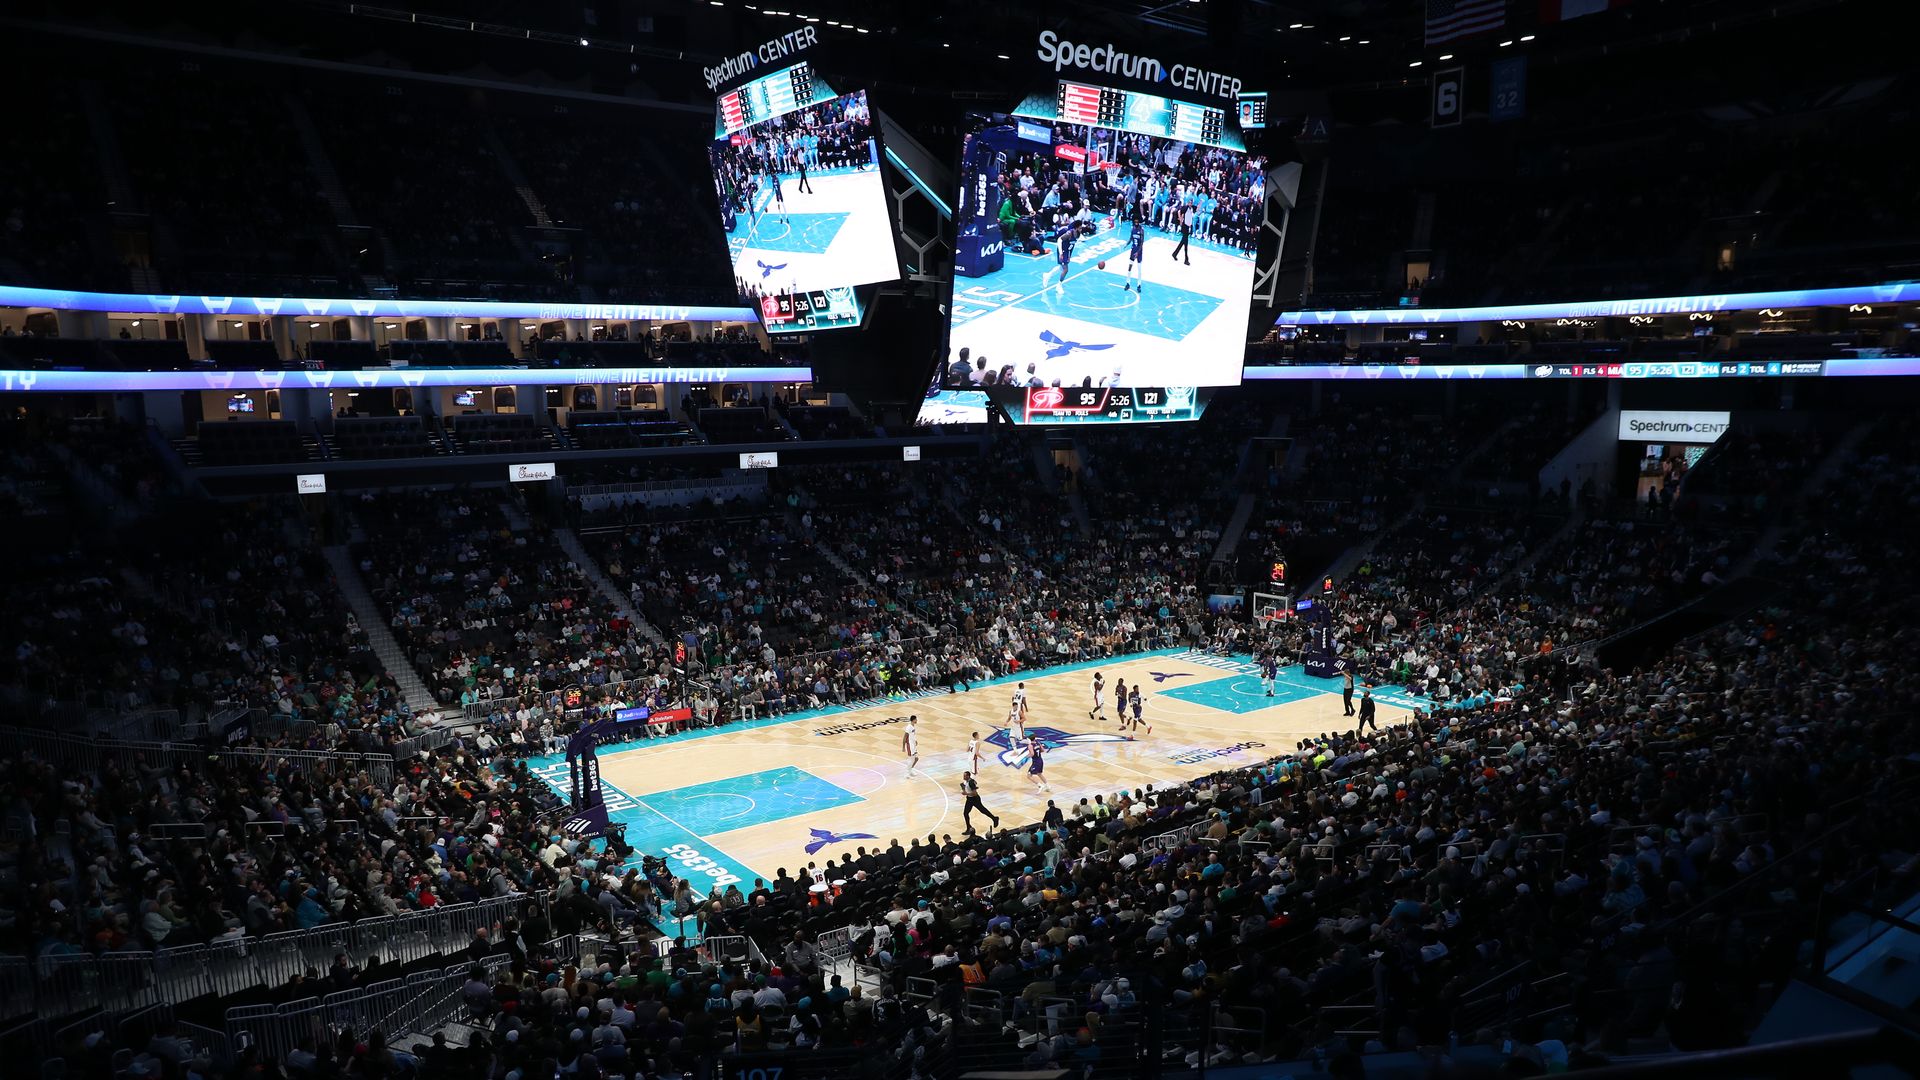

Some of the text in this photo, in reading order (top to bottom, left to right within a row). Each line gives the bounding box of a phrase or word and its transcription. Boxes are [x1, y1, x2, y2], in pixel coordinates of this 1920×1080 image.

[704, 26, 818, 92] Spectrum CENTER
[1037, 30, 1242, 100] Spectrum CENTER
[1437, 81, 1457, 116] 6
[977, 174, 987, 216] bet365
[780, 296, 827, 311] 95 5:26 121
[1568, 297, 1727, 317] HIVE MENTALITY
[540, 305, 690, 320] HIVE MENTALITY
[575, 368, 728, 383] HIVE MENTALITY
[1574, 367, 1579, 375] 1
[1597, 367, 1604, 375] 4
[1608, 367, 1623, 375] MIA
[1629, 366, 1642, 375] 95
[1650, 366, 1673, 375] 5:26
[1681, 365, 1695, 374] 121
[1701, 365, 1719, 374] CHA
[1722, 366, 1737, 374] FLS
[1740, 365, 1746, 373] 2
[1769, 365, 1777, 373] 4
[1080, 392, 1158, 406] 95 5:26 121
[1630, 419, 1729, 433] Spectrum CENT
[1307, 660, 1326, 668] KIA
[567, 697, 580, 706] 24
[1181, 741, 1266, 764] Spectrum
[589, 759, 599, 791] bet365
[661, 843, 743, 887] bet365
[815, 873, 824, 883] 16
[736, 1066, 784, 1080] 107
